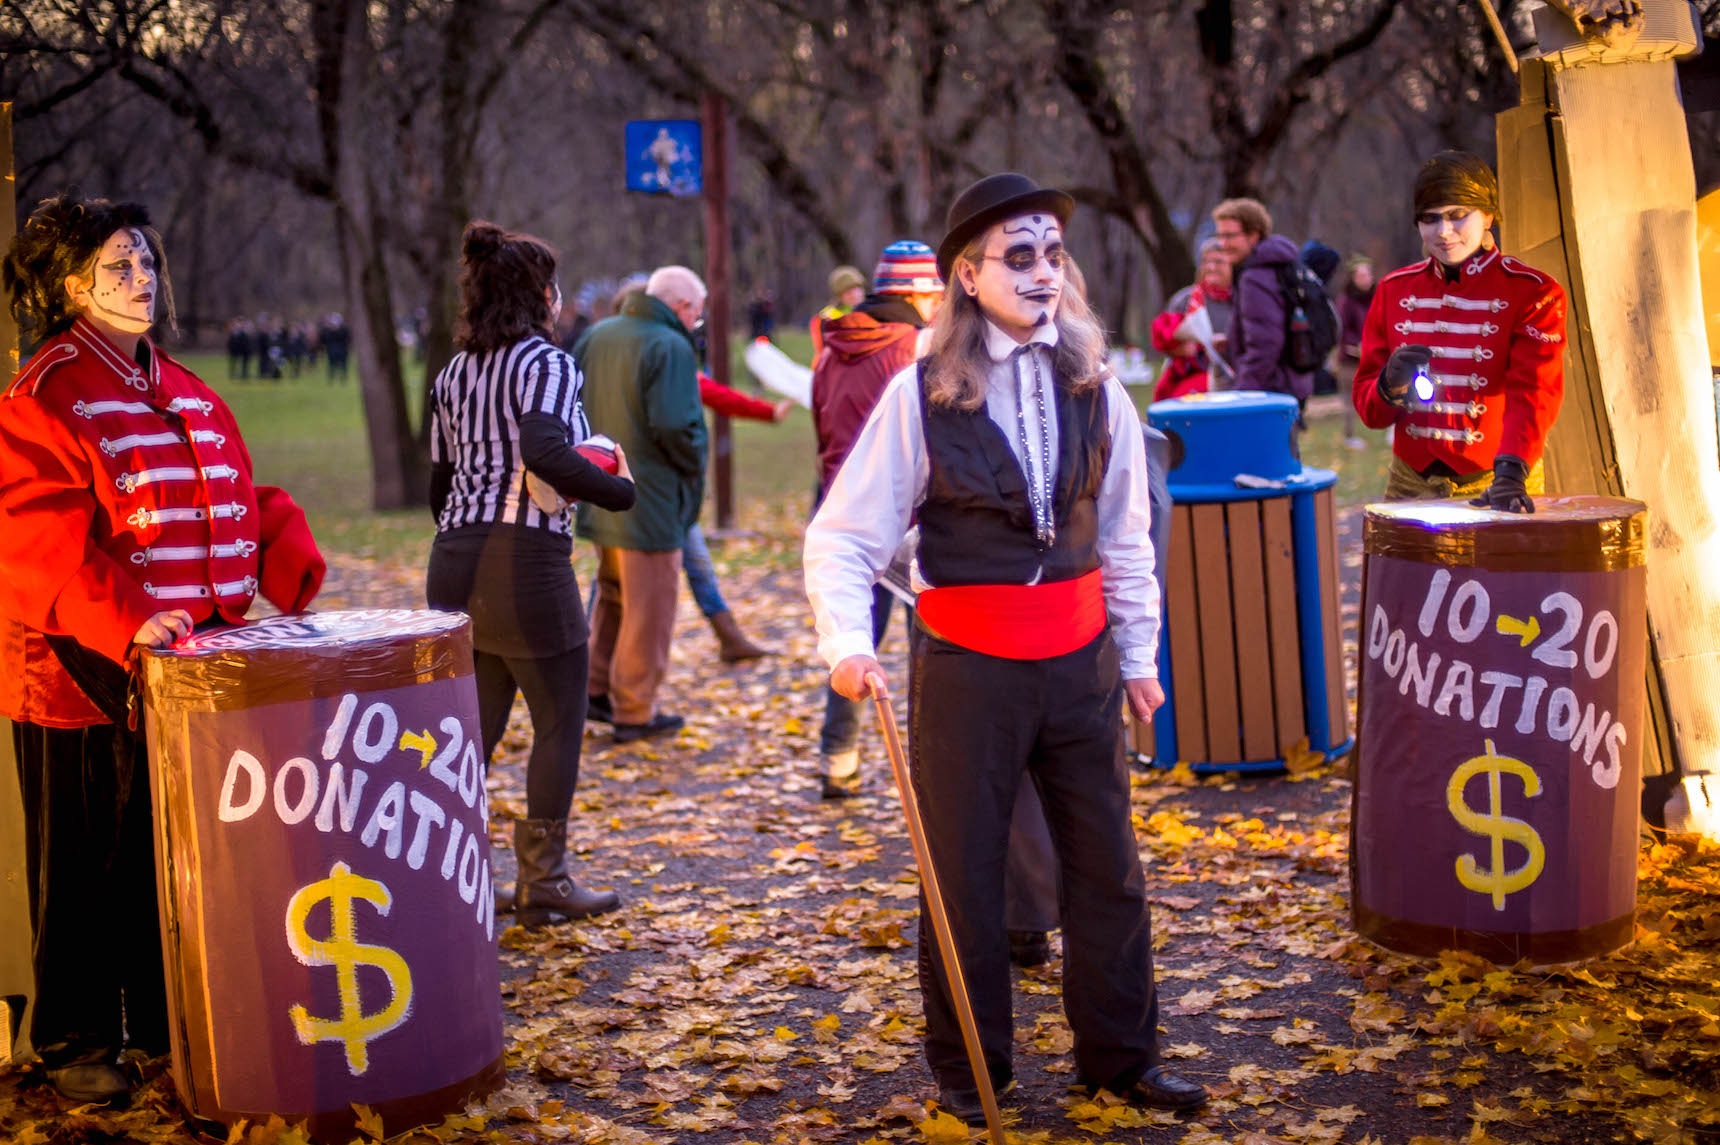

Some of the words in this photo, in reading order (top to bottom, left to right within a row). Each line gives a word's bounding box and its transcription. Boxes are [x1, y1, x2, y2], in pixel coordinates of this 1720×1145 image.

[1368, 604, 1627, 790] DONATIONS
[1418, 568, 1491, 643] 10
[1531, 591, 1618, 679] 20
[321, 693, 399, 763] 10
[218, 749, 496, 942] DONATION
[1446, 738, 1546, 911] $
[284, 860, 414, 1077] $
